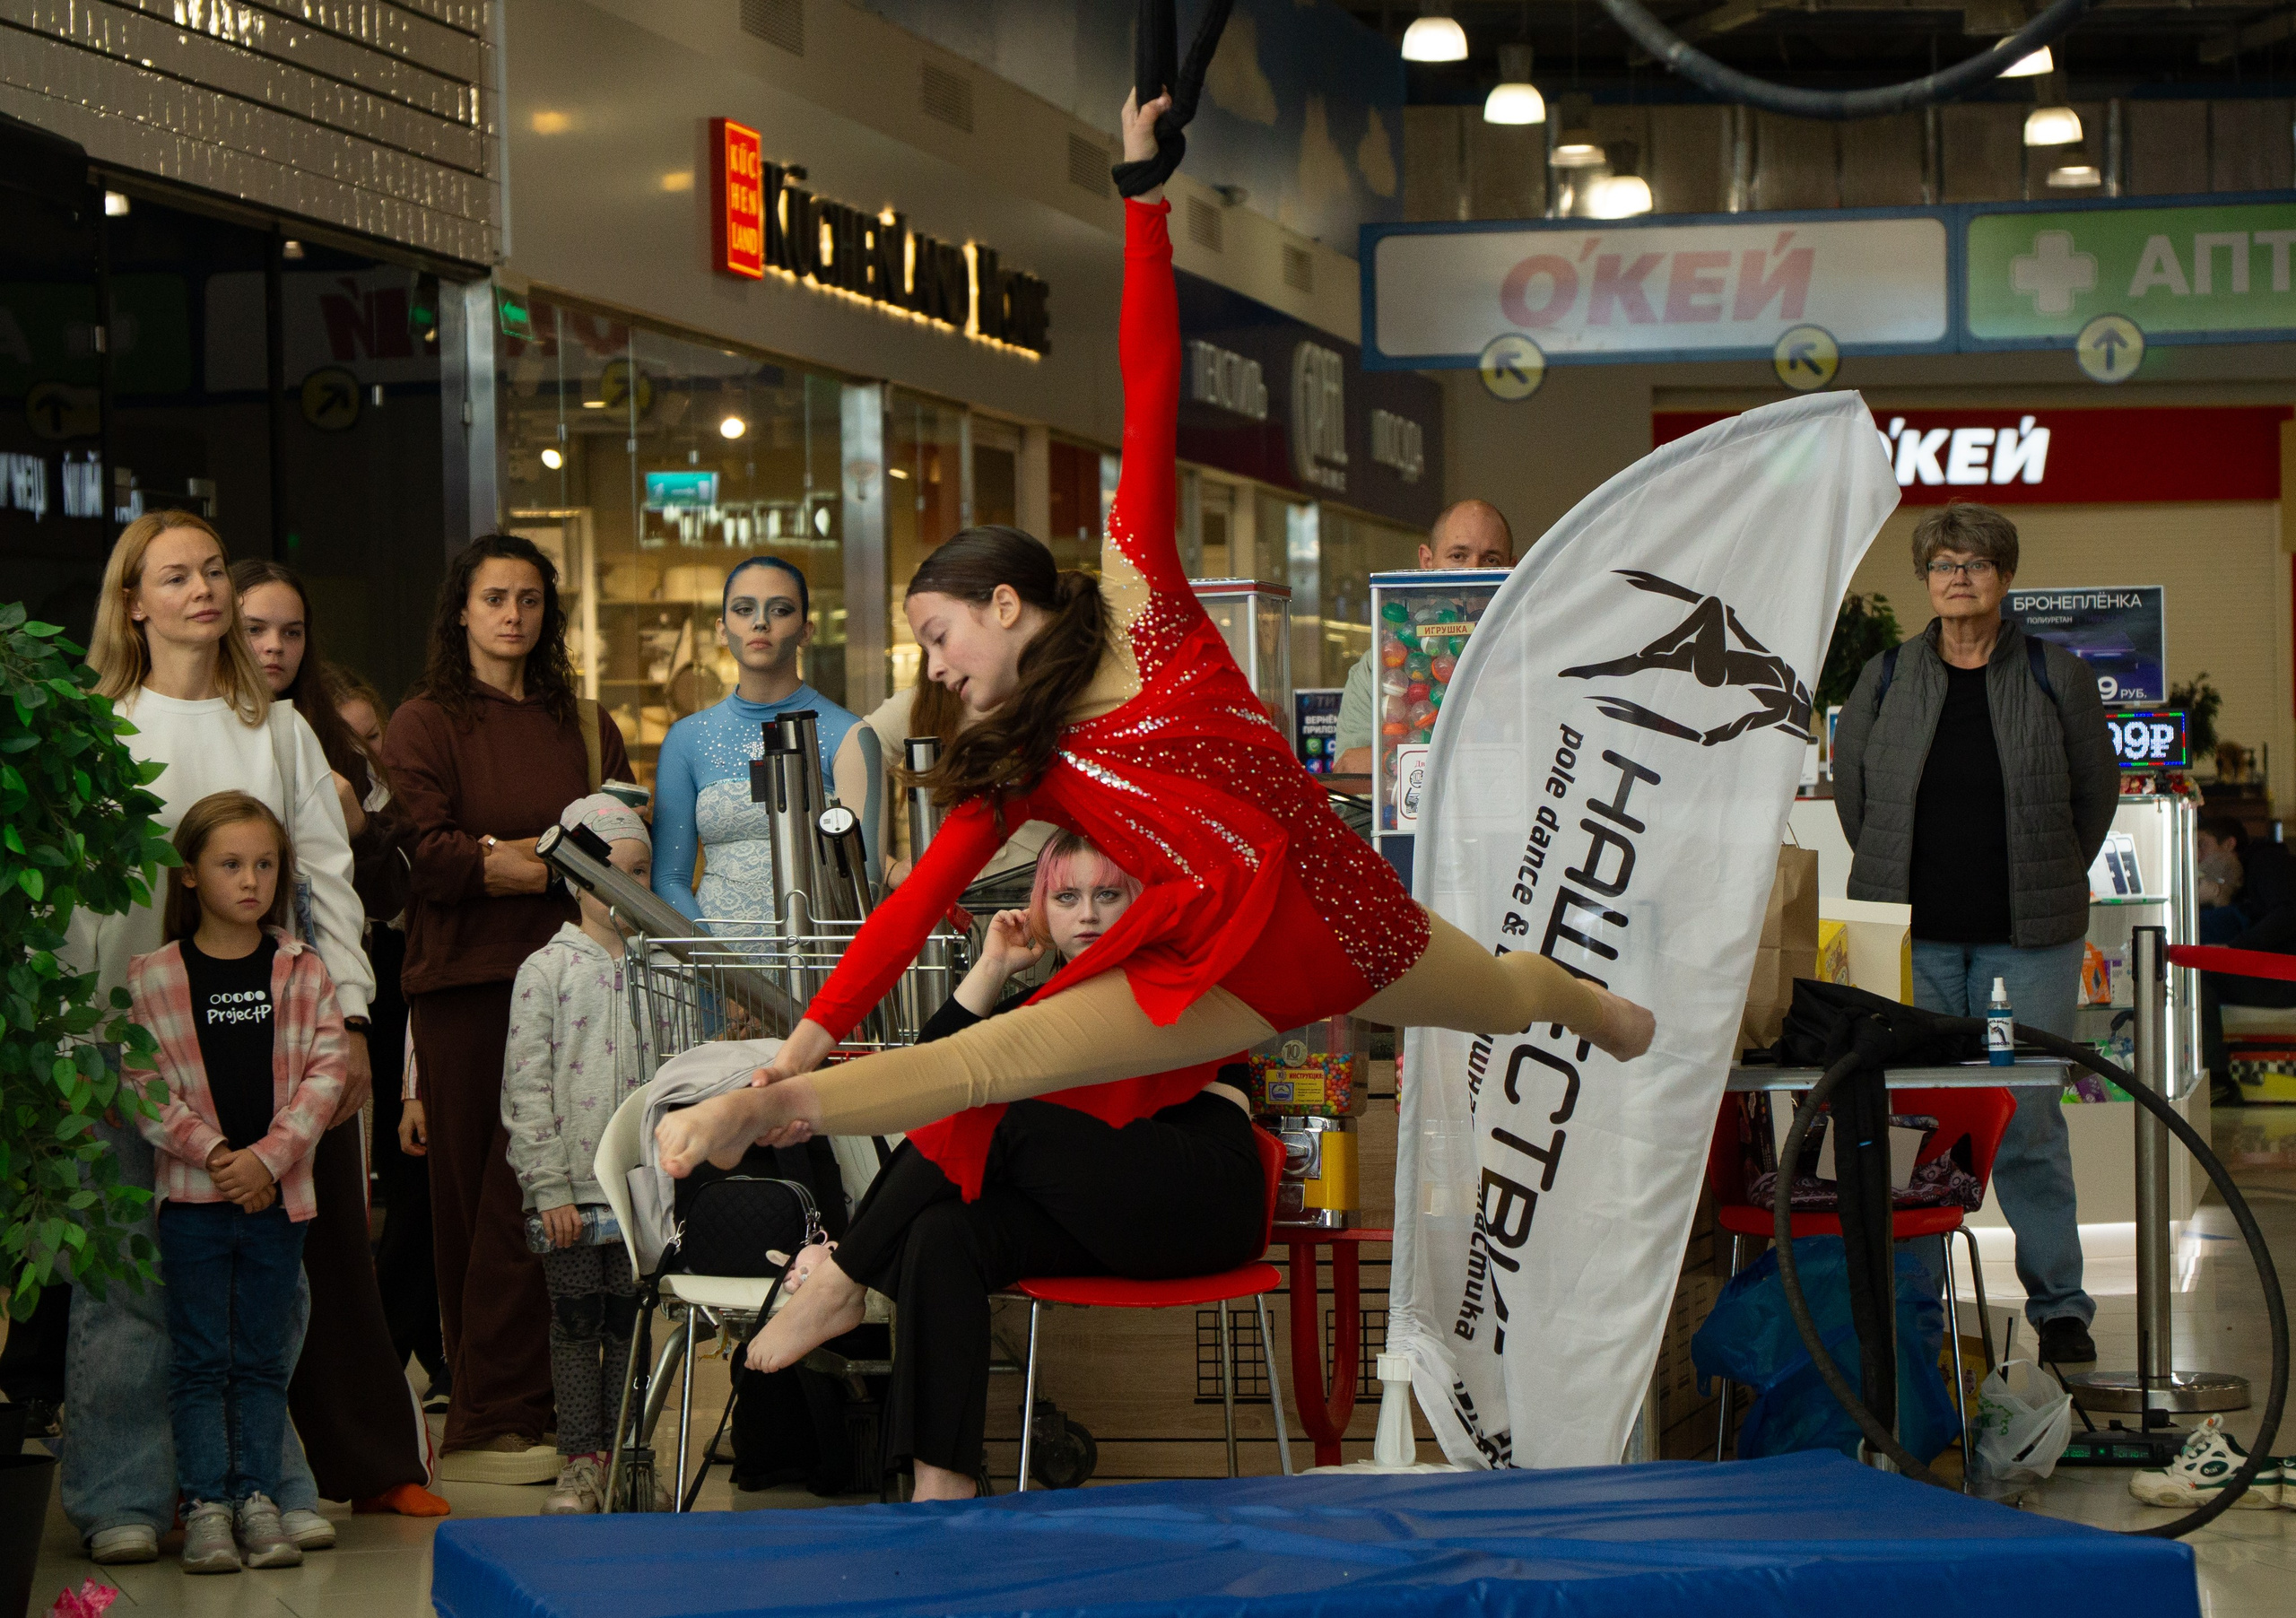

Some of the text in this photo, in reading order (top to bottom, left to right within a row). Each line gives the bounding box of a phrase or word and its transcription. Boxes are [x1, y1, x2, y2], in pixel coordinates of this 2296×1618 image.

[1878, 414, 2052, 487] 'КЕЙ
[2013, 591, 2143, 612] БРОНЕПЛЁНКА
[1423, 624, 1469, 636] ИГРУШКА
[2026, 615, 2073, 625] ПОЛИУРЕТАН
[1544, 722, 1584, 800] pole
[1511, 805, 1561, 905] dance
[206, 1004, 272, 1024] ProjectP
[1284, 1045, 1300, 1059] 10
